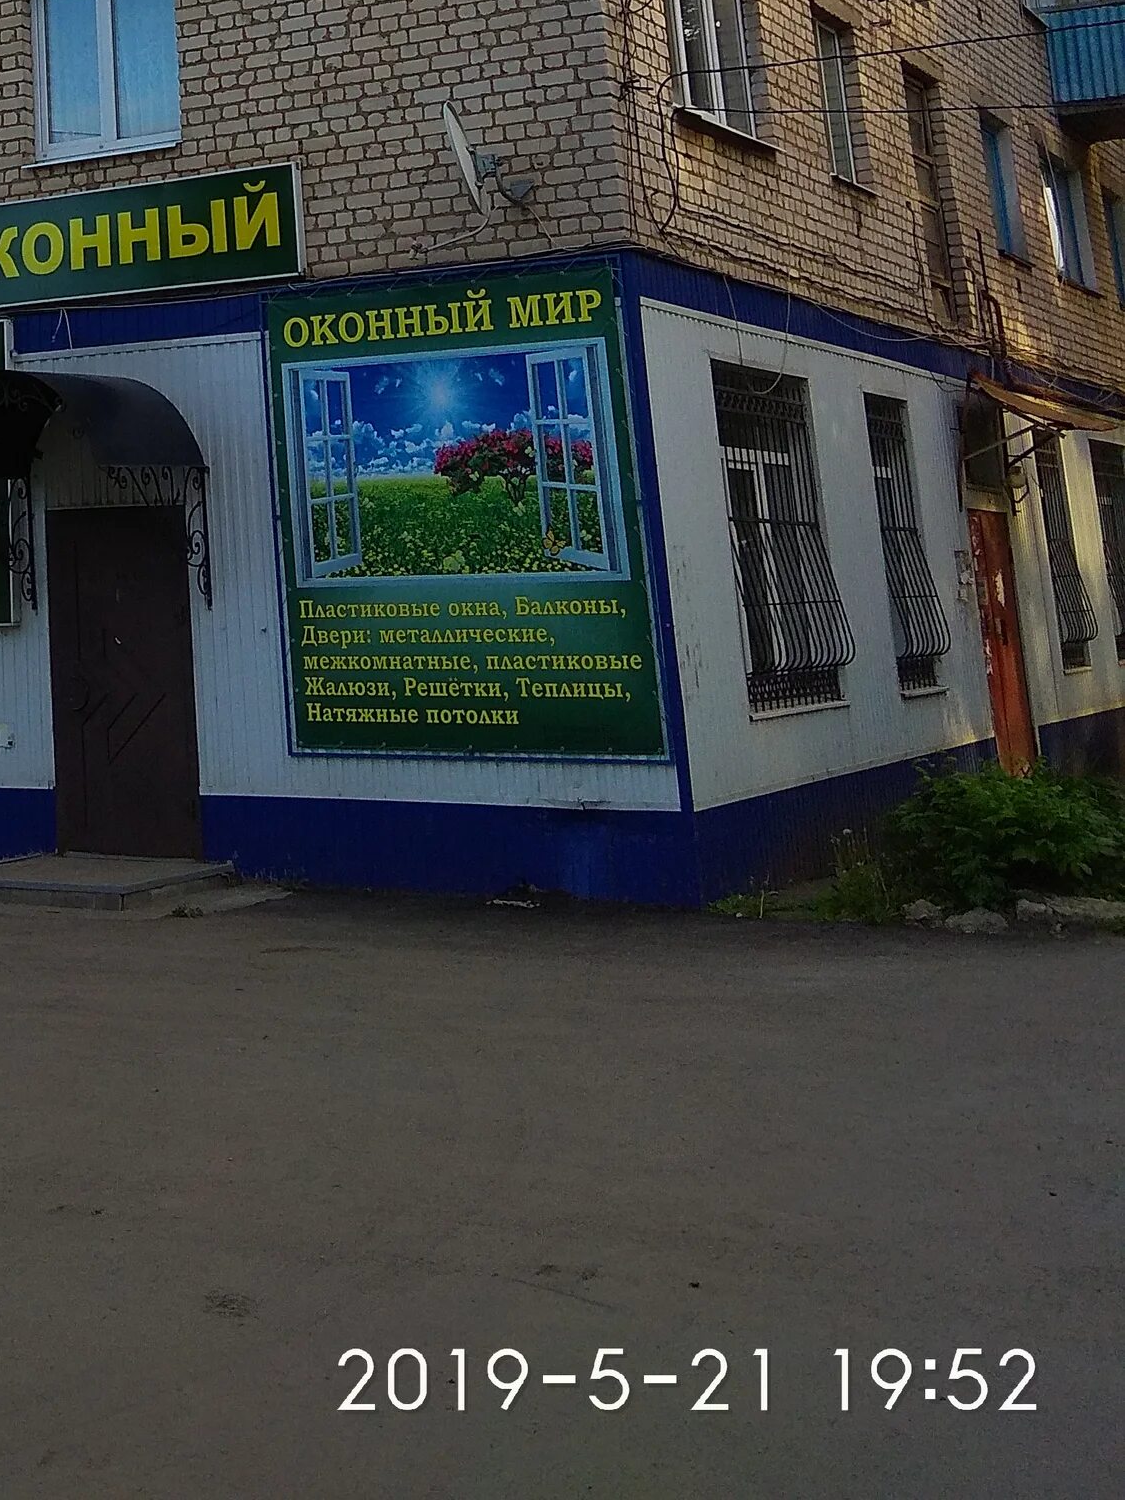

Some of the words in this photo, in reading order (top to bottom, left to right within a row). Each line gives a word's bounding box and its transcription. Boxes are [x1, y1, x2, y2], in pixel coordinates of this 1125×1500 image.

[283, 289, 494, 348] ОКОННЫЙ
[507, 288, 602, 330] МИР
[299, 599, 440, 619] Пластиковые
[448, 600, 508, 619] окна,
[515, 596, 626, 619] Балконы,
[301, 626, 372, 649] Двери:
[379, 627, 555, 646] металлические,
[303, 652, 479, 674] межкомнатные,
[486, 651, 642, 671] пластиковые
[304, 677, 398, 700] Жалюзи,
[404, 675, 509, 700] Решётки,
[516, 676, 632, 702] Теплицы,
[306, 703, 419, 725] Натяжные
[426, 706, 520, 725] потолки
